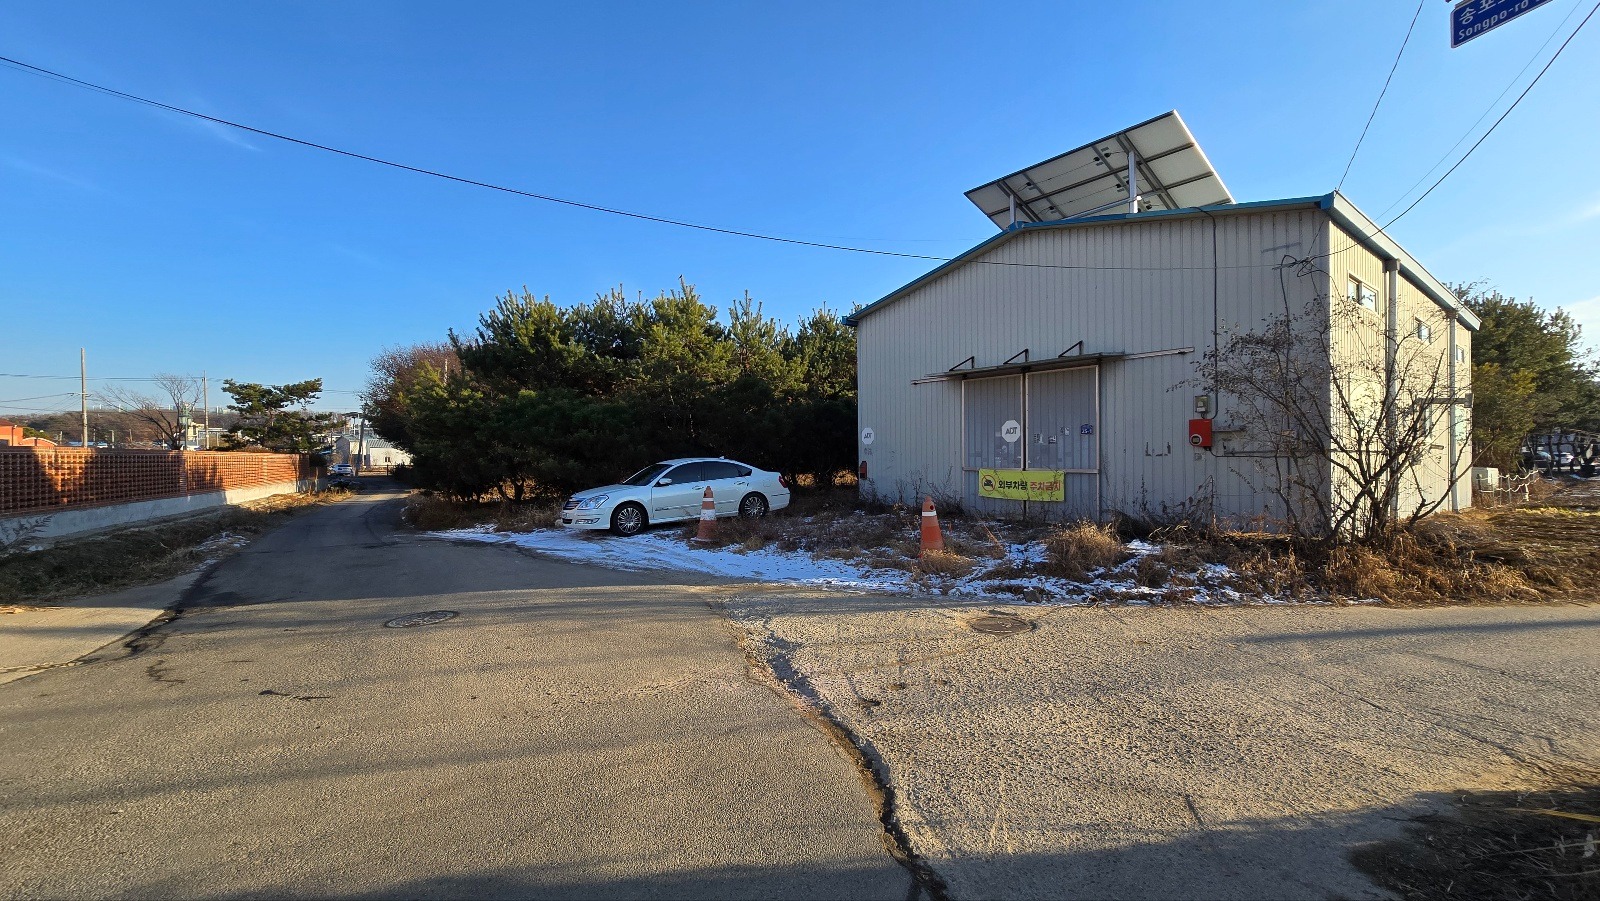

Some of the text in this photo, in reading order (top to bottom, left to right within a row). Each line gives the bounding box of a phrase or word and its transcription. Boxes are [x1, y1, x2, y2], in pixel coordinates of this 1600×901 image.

[1459, 0, 1505, 25] 송포
[1459, 0, 1529, 40] Songpo-ro
[1005, 426, 1018, 436] ADT
[998, 480, 1028, 491] 외부차량
